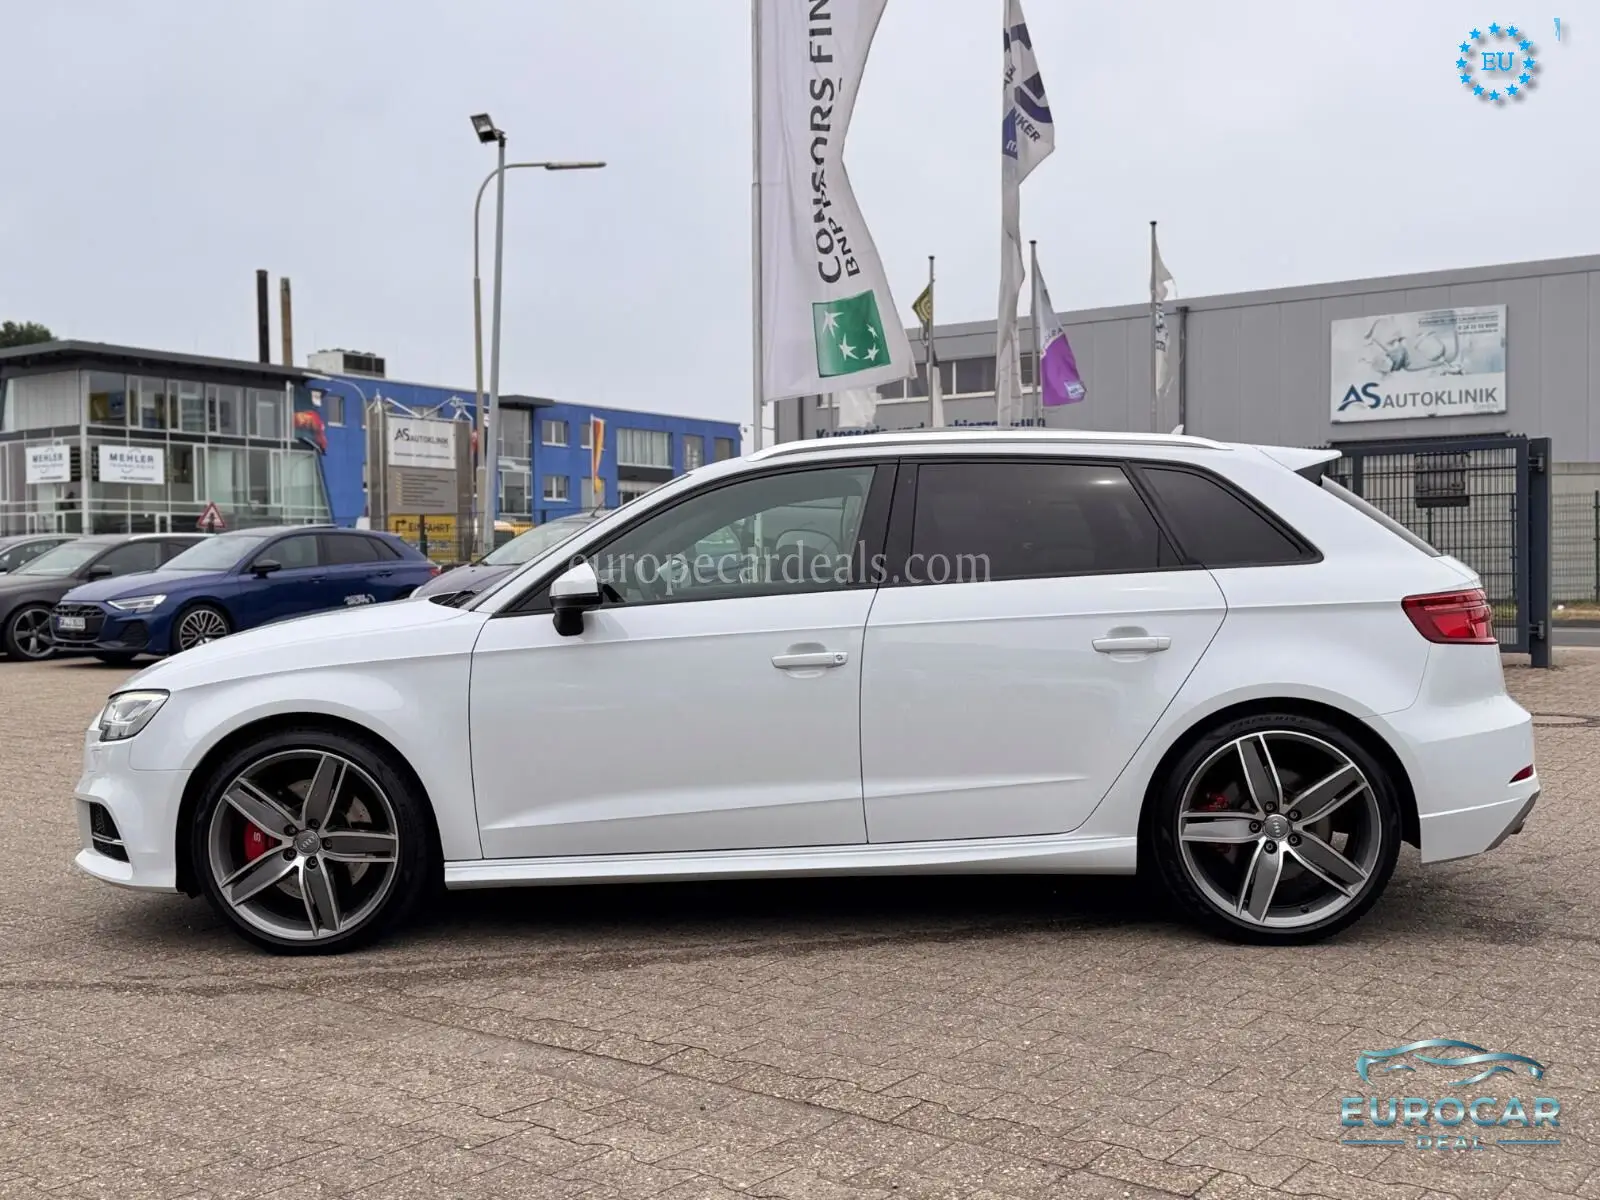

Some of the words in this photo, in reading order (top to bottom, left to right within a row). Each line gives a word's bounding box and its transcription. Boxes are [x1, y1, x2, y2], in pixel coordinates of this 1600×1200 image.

[827, 216, 860, 278] BNP
[1383, 387, 1498, 409] AUTOKLINIK
[32, 452, 63, 463] MEHLER
[109, 453, 155, 463] MEHLER
